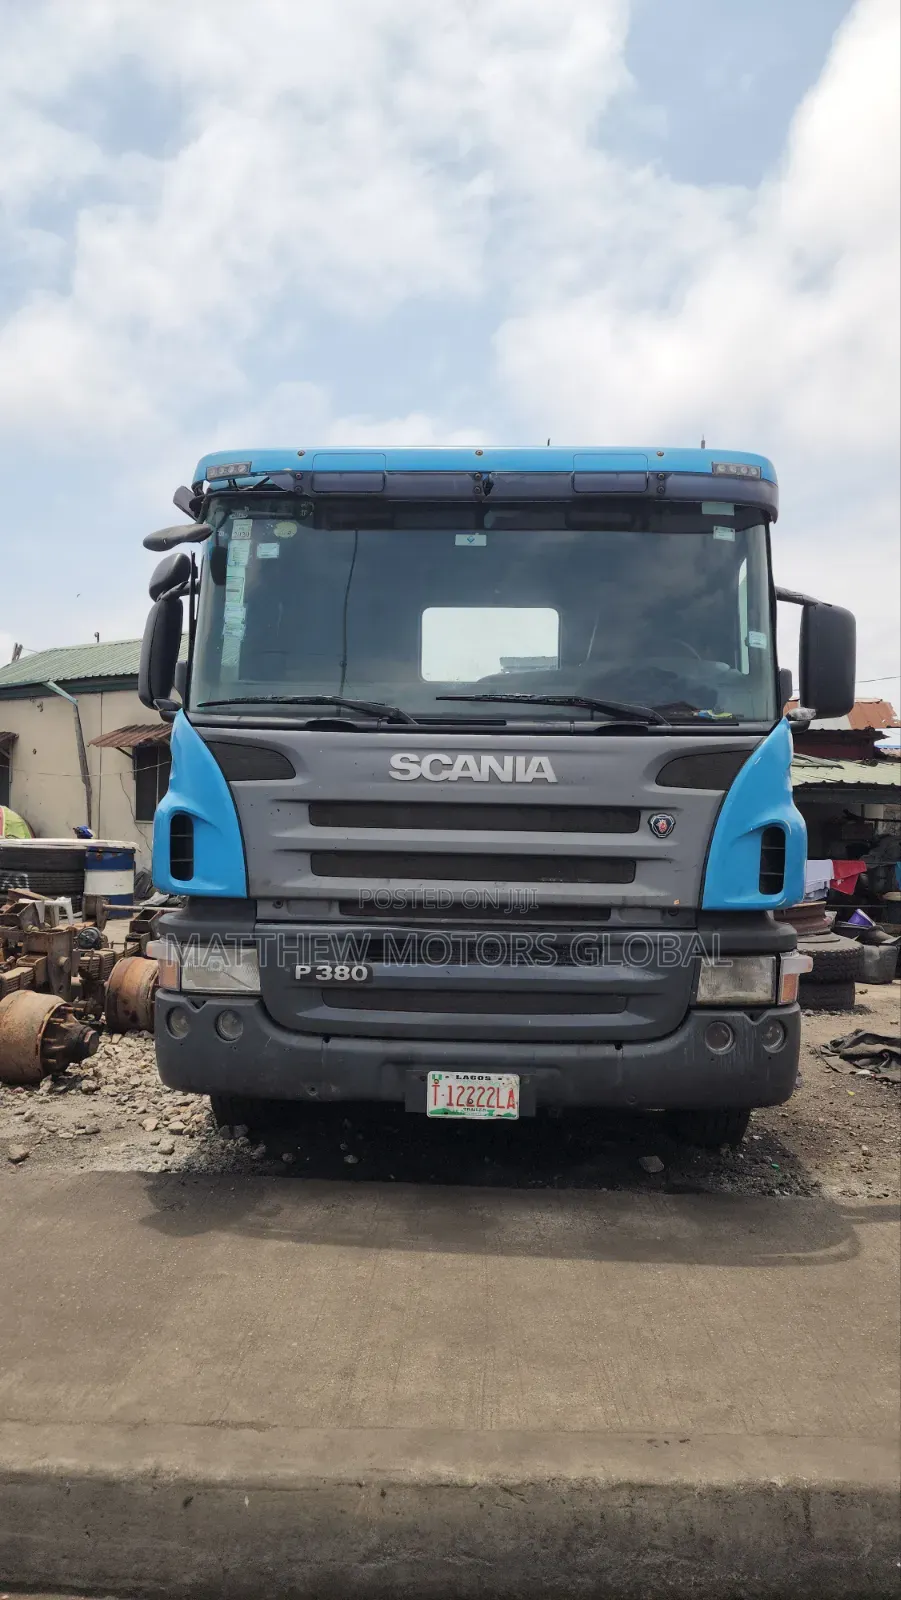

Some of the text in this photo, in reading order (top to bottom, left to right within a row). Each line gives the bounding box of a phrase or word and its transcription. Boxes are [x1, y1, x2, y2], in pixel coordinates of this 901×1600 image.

[388, 753, 558, 783] SCANIA
[295, 965, 368, 981] P 380
